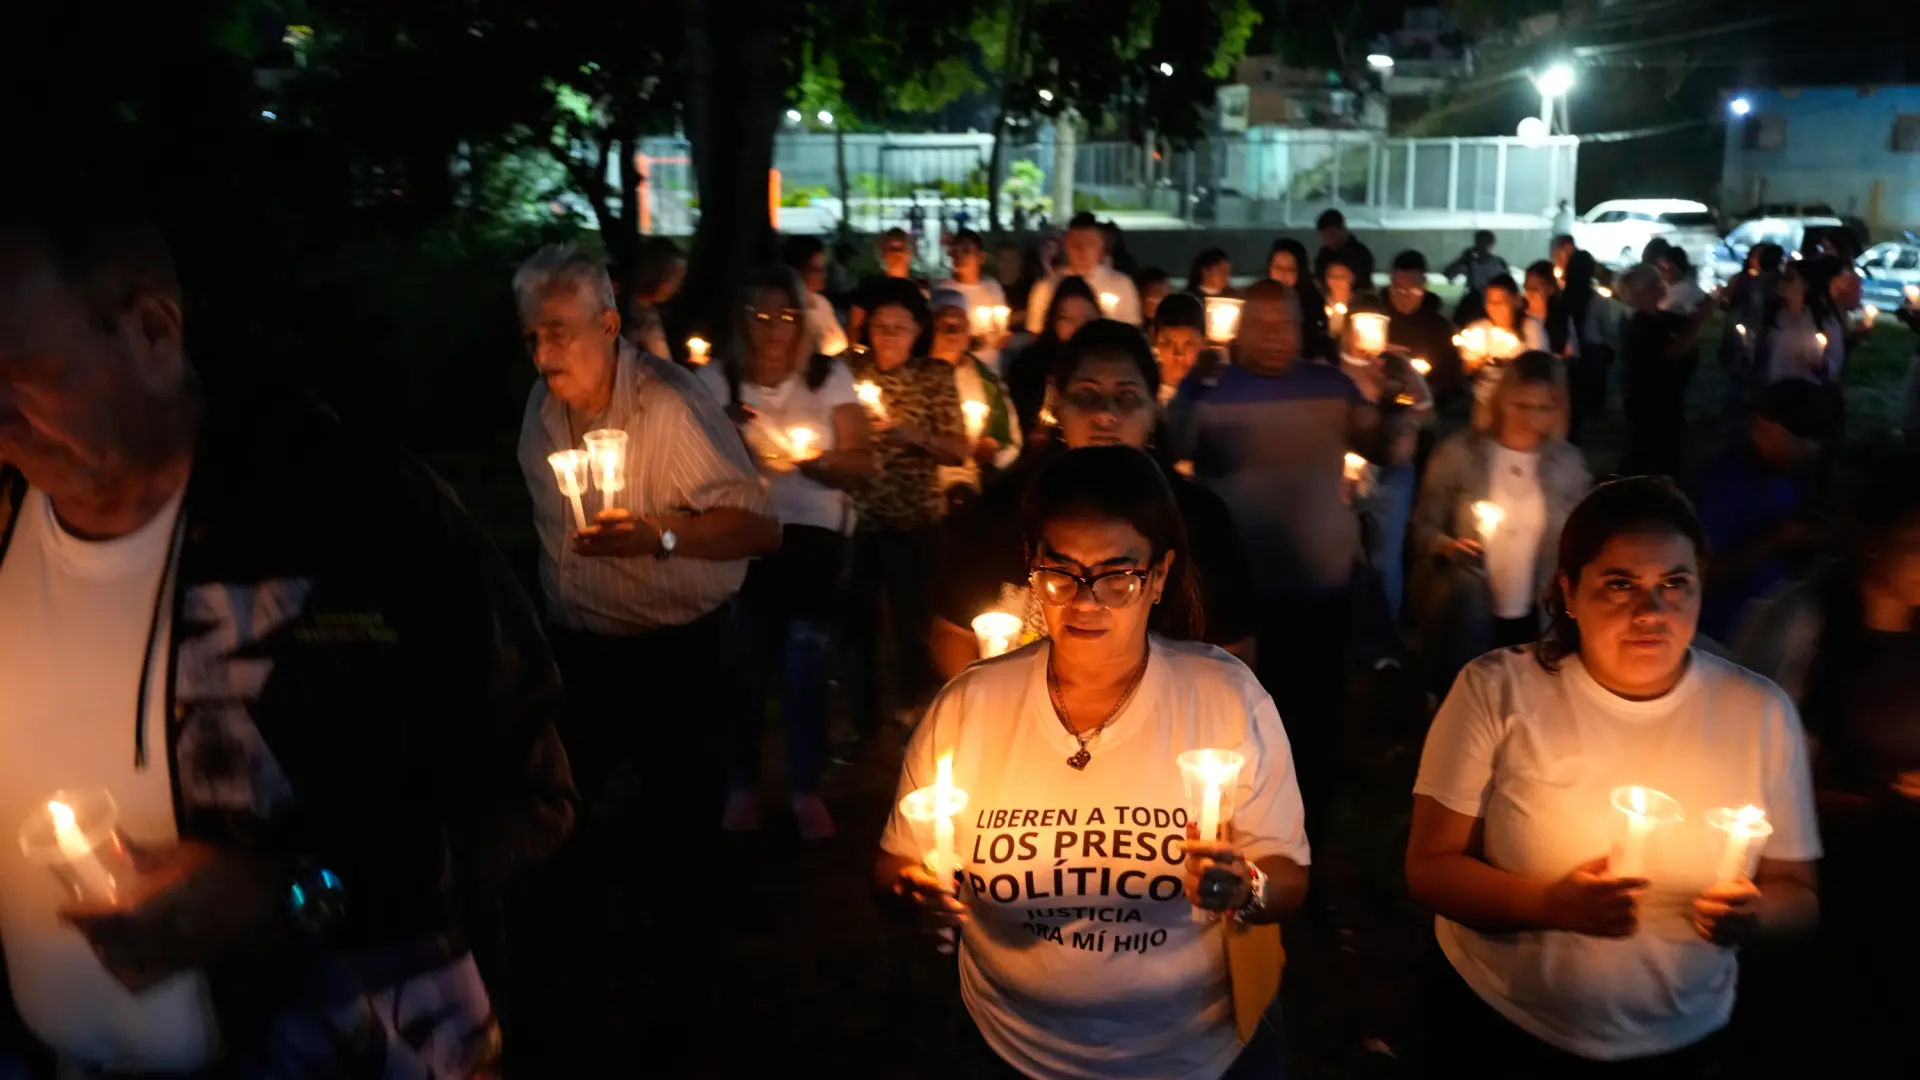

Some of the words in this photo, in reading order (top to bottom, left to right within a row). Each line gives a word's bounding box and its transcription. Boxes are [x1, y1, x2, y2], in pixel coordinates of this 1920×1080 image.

[976, 808, 1078, 830] LIBEREN
[1086, 807, 1106, 826] A
[1113, 806, 1189, 829] TODO
[972, 831, 1038, 865] LOS
[1053, 829, 1187, 866] PRESO
[968, 858, 1187, 904] POLÍTICO
[1072, 930, 1108, 953] MÍ
[1114, 928, 1168, 954] HIJO
